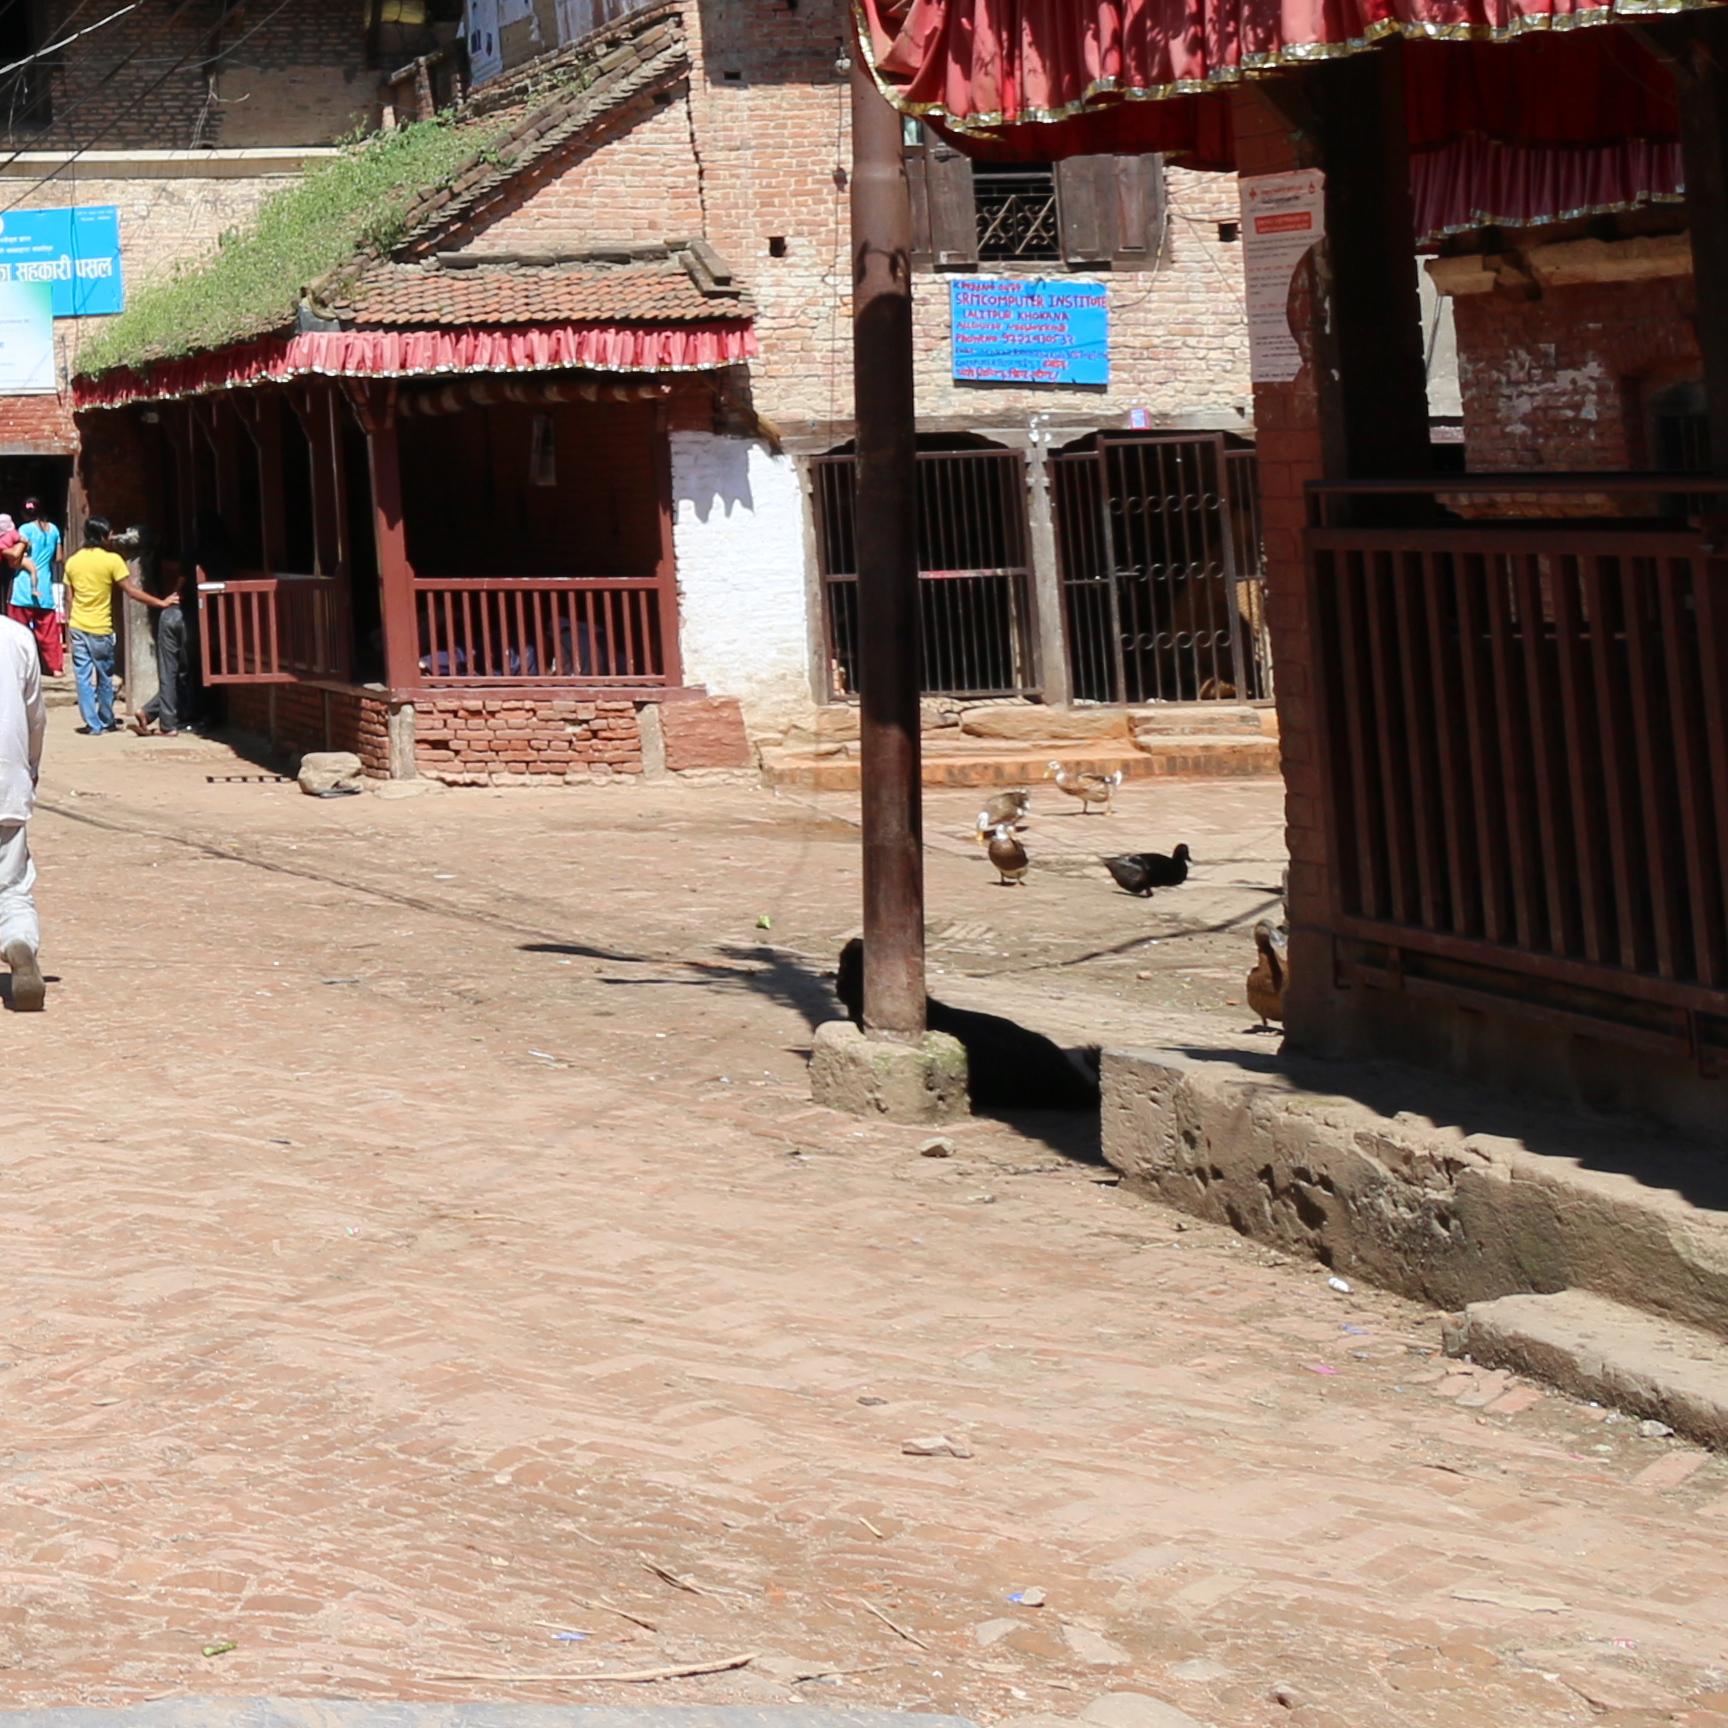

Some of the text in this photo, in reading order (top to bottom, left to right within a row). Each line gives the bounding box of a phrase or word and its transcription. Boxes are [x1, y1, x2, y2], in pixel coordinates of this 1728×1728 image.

[16, 255, 71, 281] सहकारी
[75, 257, 113, 278] पसल
[1049, 294, 1108, 308] INSTITUTE
[1018, 311, 1070, 321] KHOKANA
